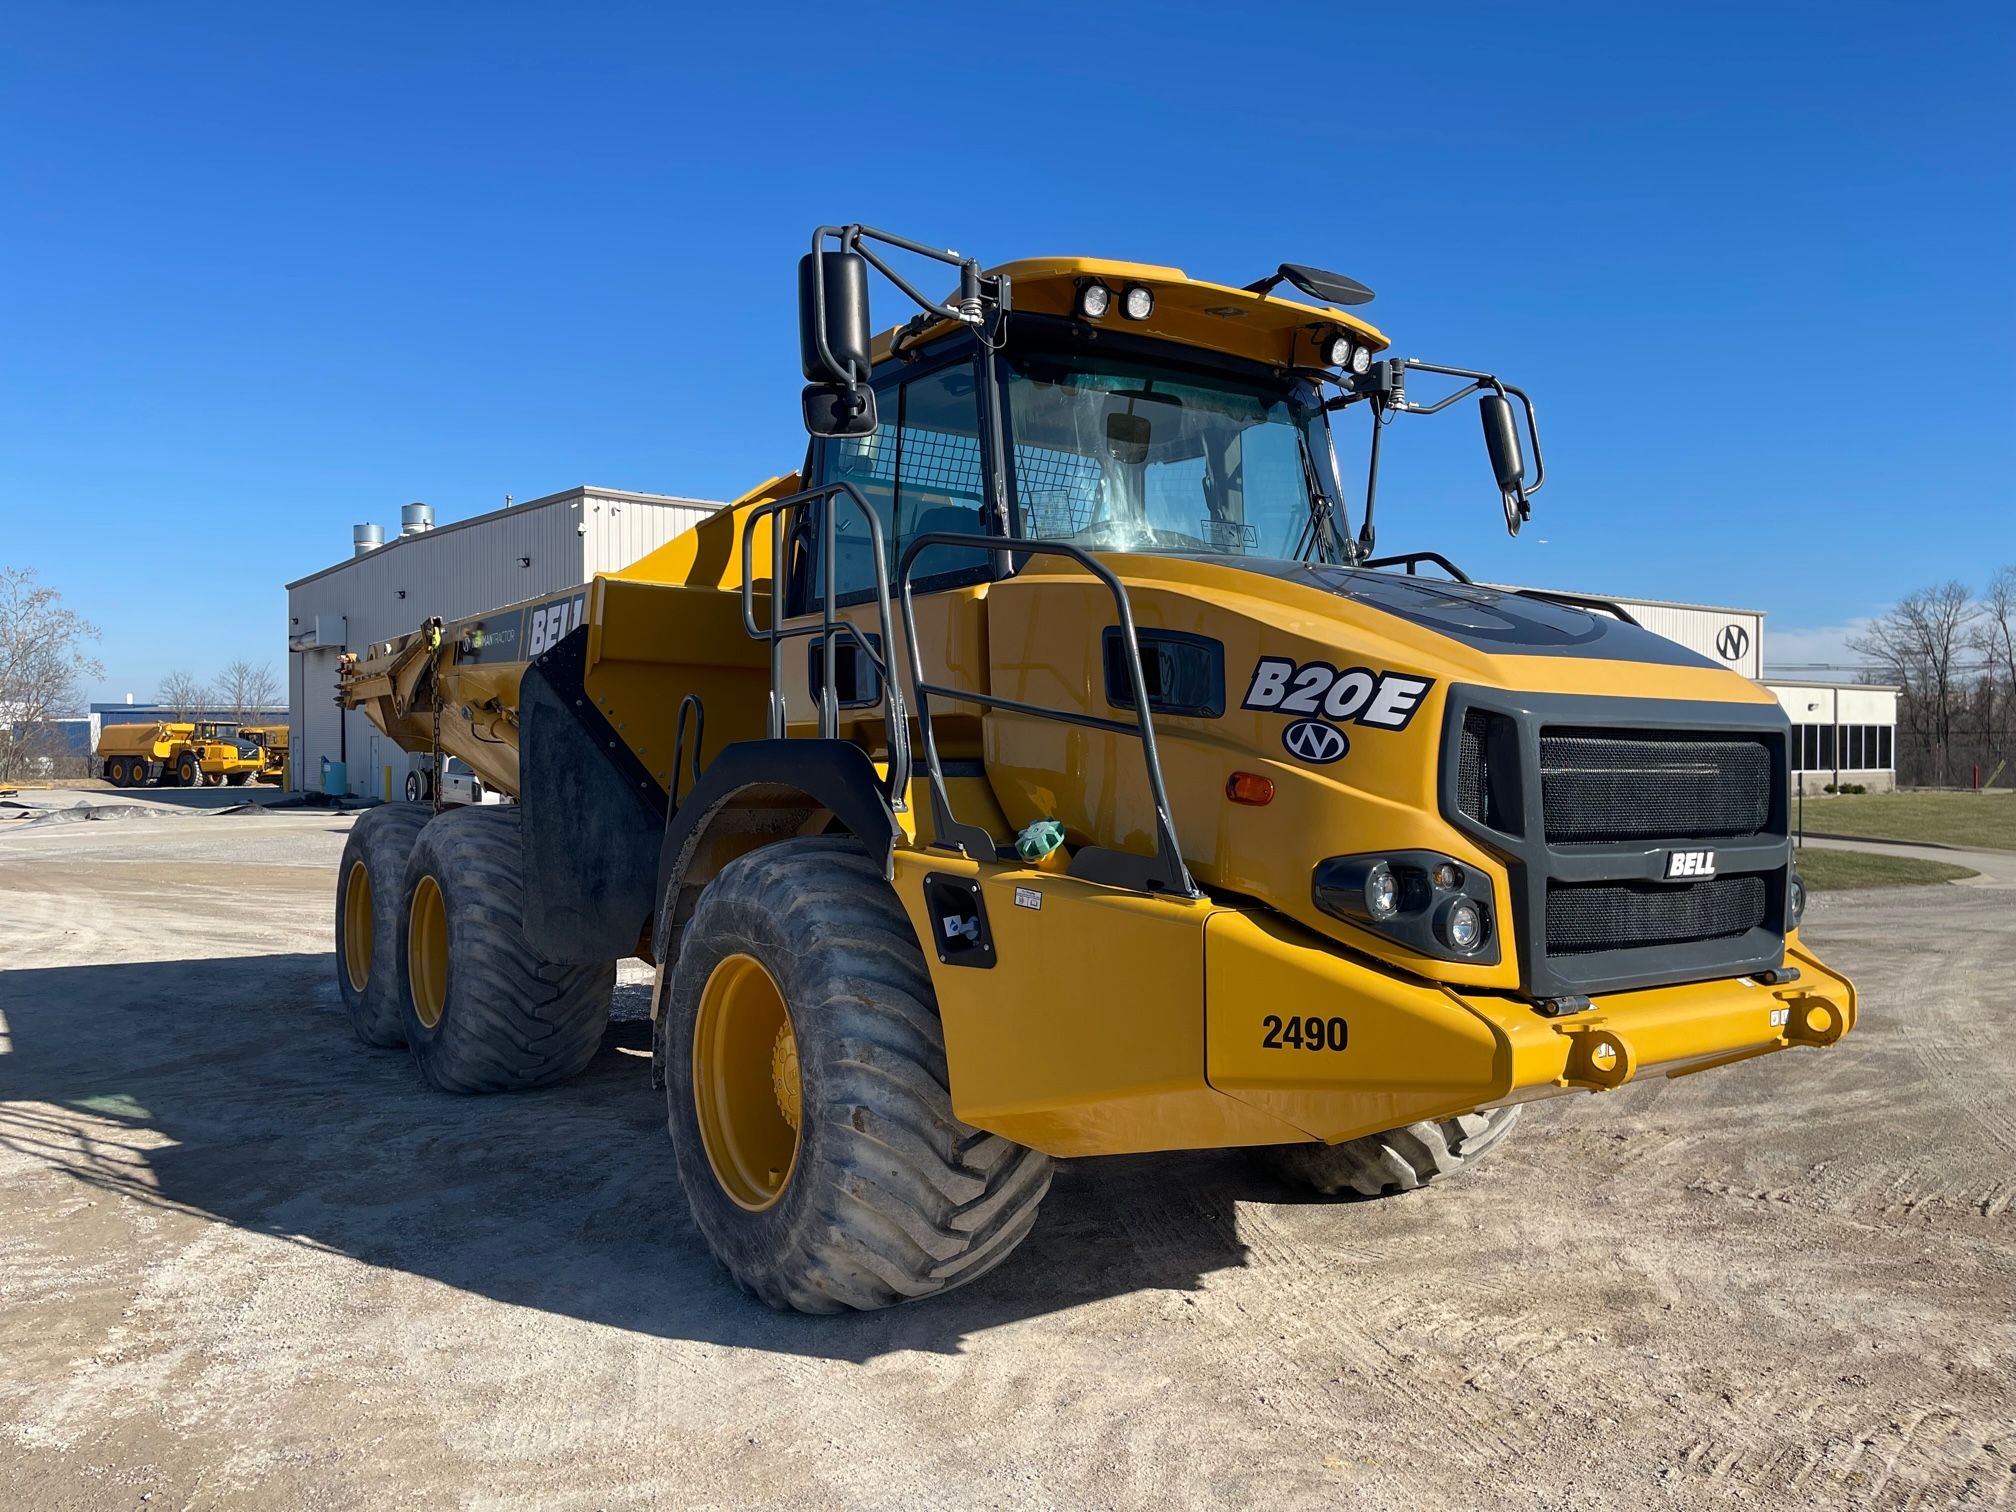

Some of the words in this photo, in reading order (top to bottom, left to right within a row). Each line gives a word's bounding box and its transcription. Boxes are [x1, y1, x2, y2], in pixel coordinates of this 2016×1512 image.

[1244, 659, 1430, 728] B20E
[1286, 722, 1345, 761] N
[1669, 851, 1716, 877] BELL
[1262, 1014, 1348, 1052] 2490
